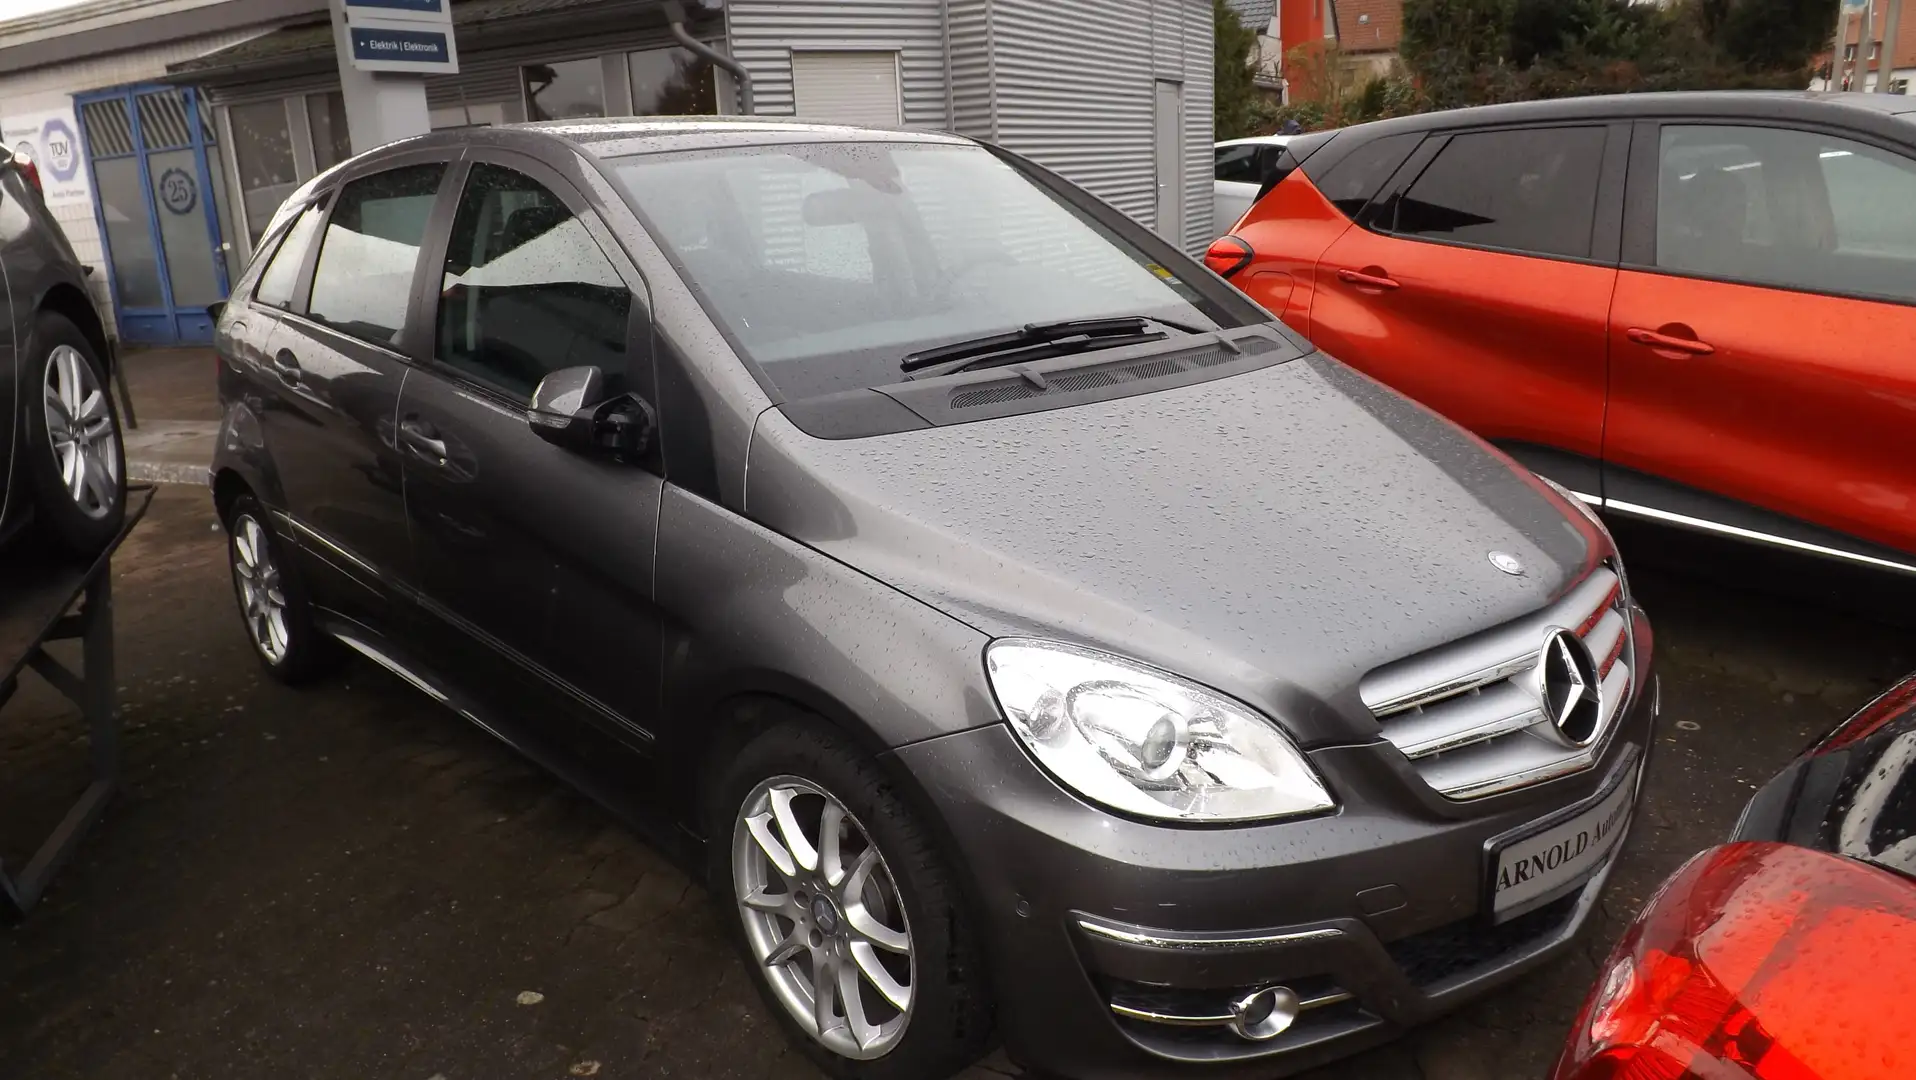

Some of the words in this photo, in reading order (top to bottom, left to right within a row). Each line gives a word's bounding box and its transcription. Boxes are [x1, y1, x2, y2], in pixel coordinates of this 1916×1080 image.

[369, 40, 399, 50] Elektrik
[403, 41, 439, 52] Elektronik
[168, 180, 188, 202] 25
[1496, 831, 1588, 892] ARNOLD
